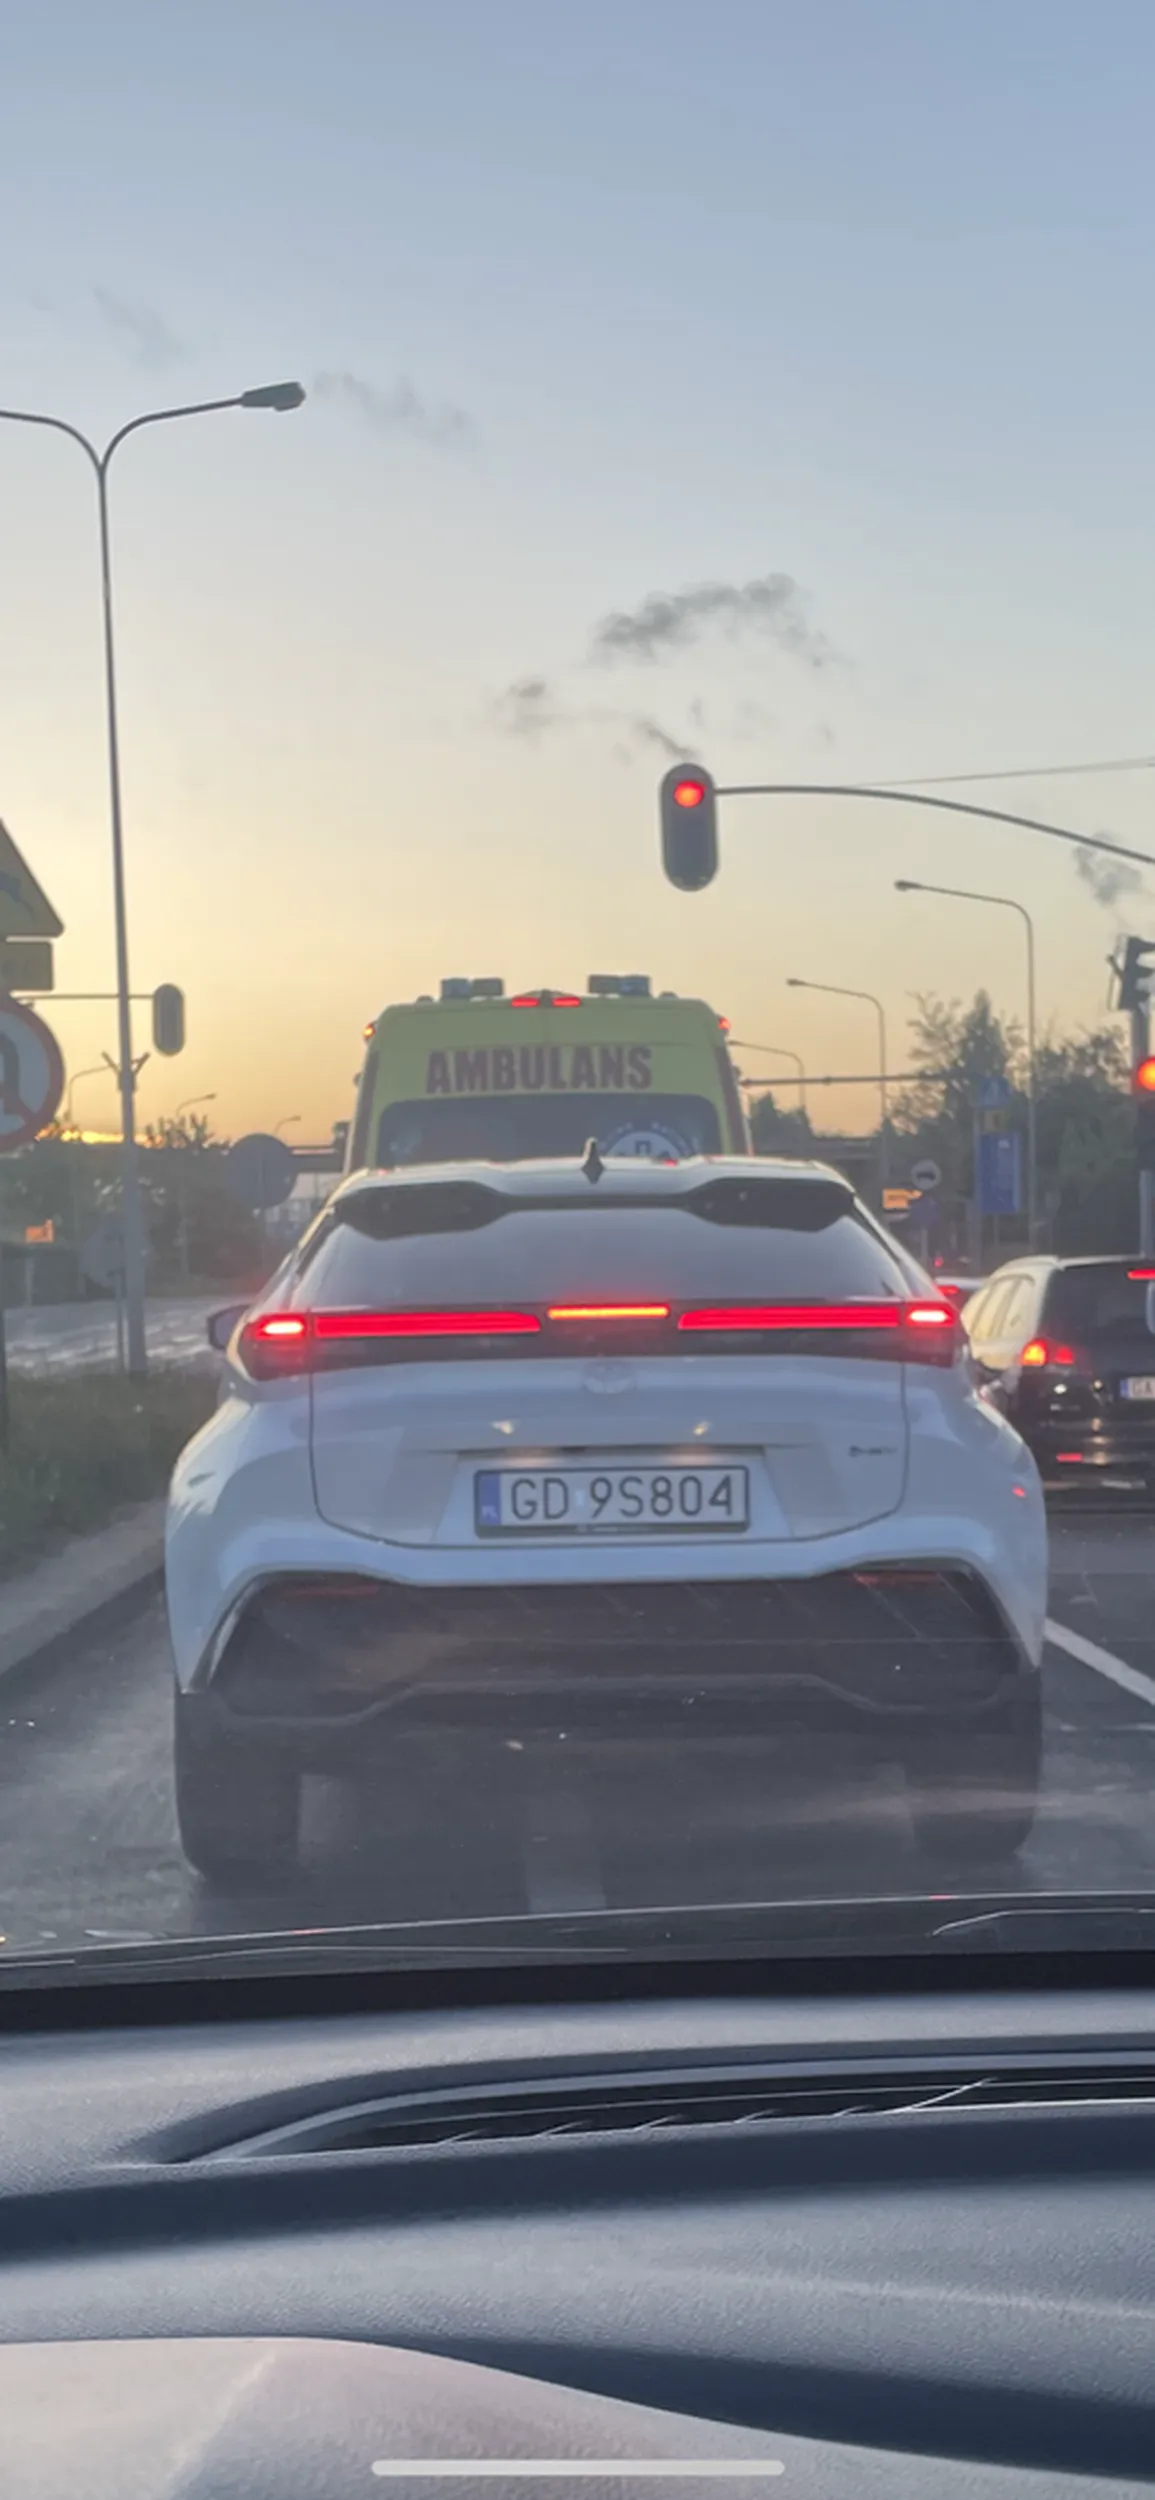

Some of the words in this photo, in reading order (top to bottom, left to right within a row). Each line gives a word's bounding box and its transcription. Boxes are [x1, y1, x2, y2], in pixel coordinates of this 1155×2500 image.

[425, 1044, 653, 1094] AMBULANS
[511, 1477, 570, 1520] GD
[589, 1474, 734, 1519] 9S804
